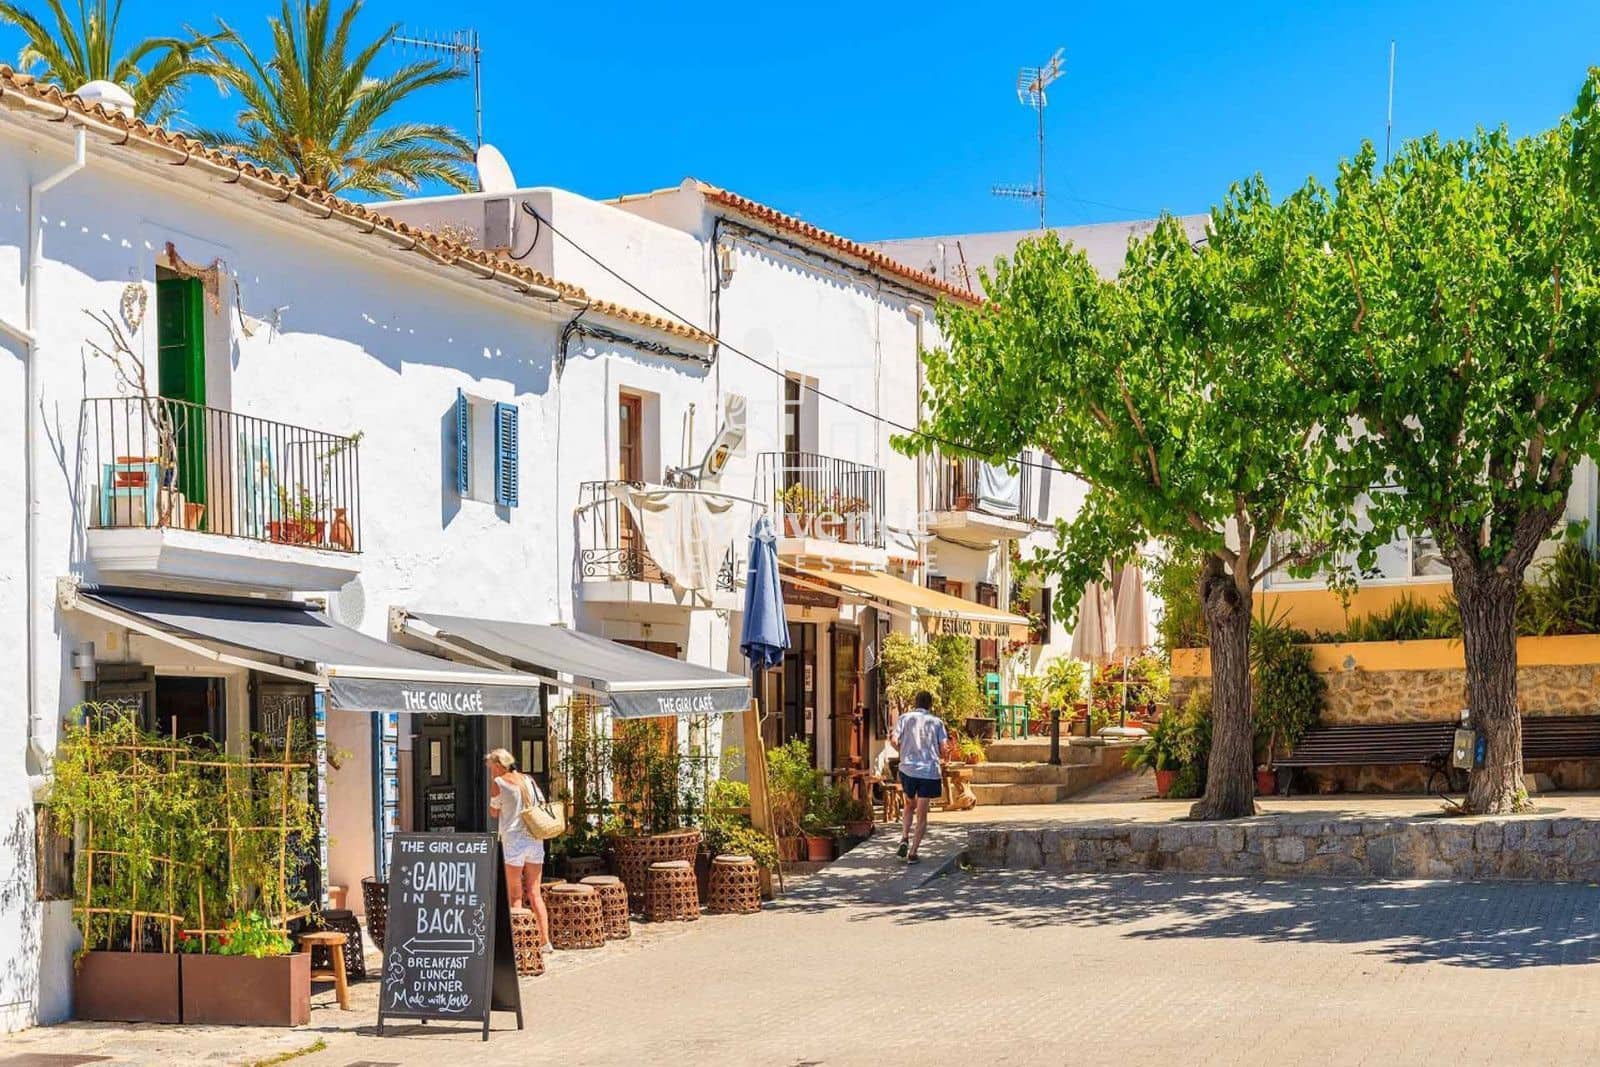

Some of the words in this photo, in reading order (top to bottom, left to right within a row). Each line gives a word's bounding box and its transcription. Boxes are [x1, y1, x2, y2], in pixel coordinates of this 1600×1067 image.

[942, 618, 972, 635] ESTANCO
[978, 622, 992, 636] SAN
[994, 622, 1010, 638] JUAN
[401, 690, 428, 710] THE
[454, 690, 484, 712] CAFÉ
[657, 697, 676, 713] THE
[693, 692, 714, 712] CAFÉ
[400, 841, 425, 853] THE
[428, 841, 453, 853] GIRI
[456, 840, 488, 854] CAFÉ
[412, 861, 476, 893] GARDEN
[402, 892, 425, 904] IN
[439, 893, 478, 906] THE
[416, 907, 465, 934] BACK
[407, 956, 469, 969] BREAKFAST
[420, 969, 456, 980] LUNCH
[413, 980, 463, 992] DINNER
[390, 988, 429, 1009] Made
[427, 993, 447, 1006] with
